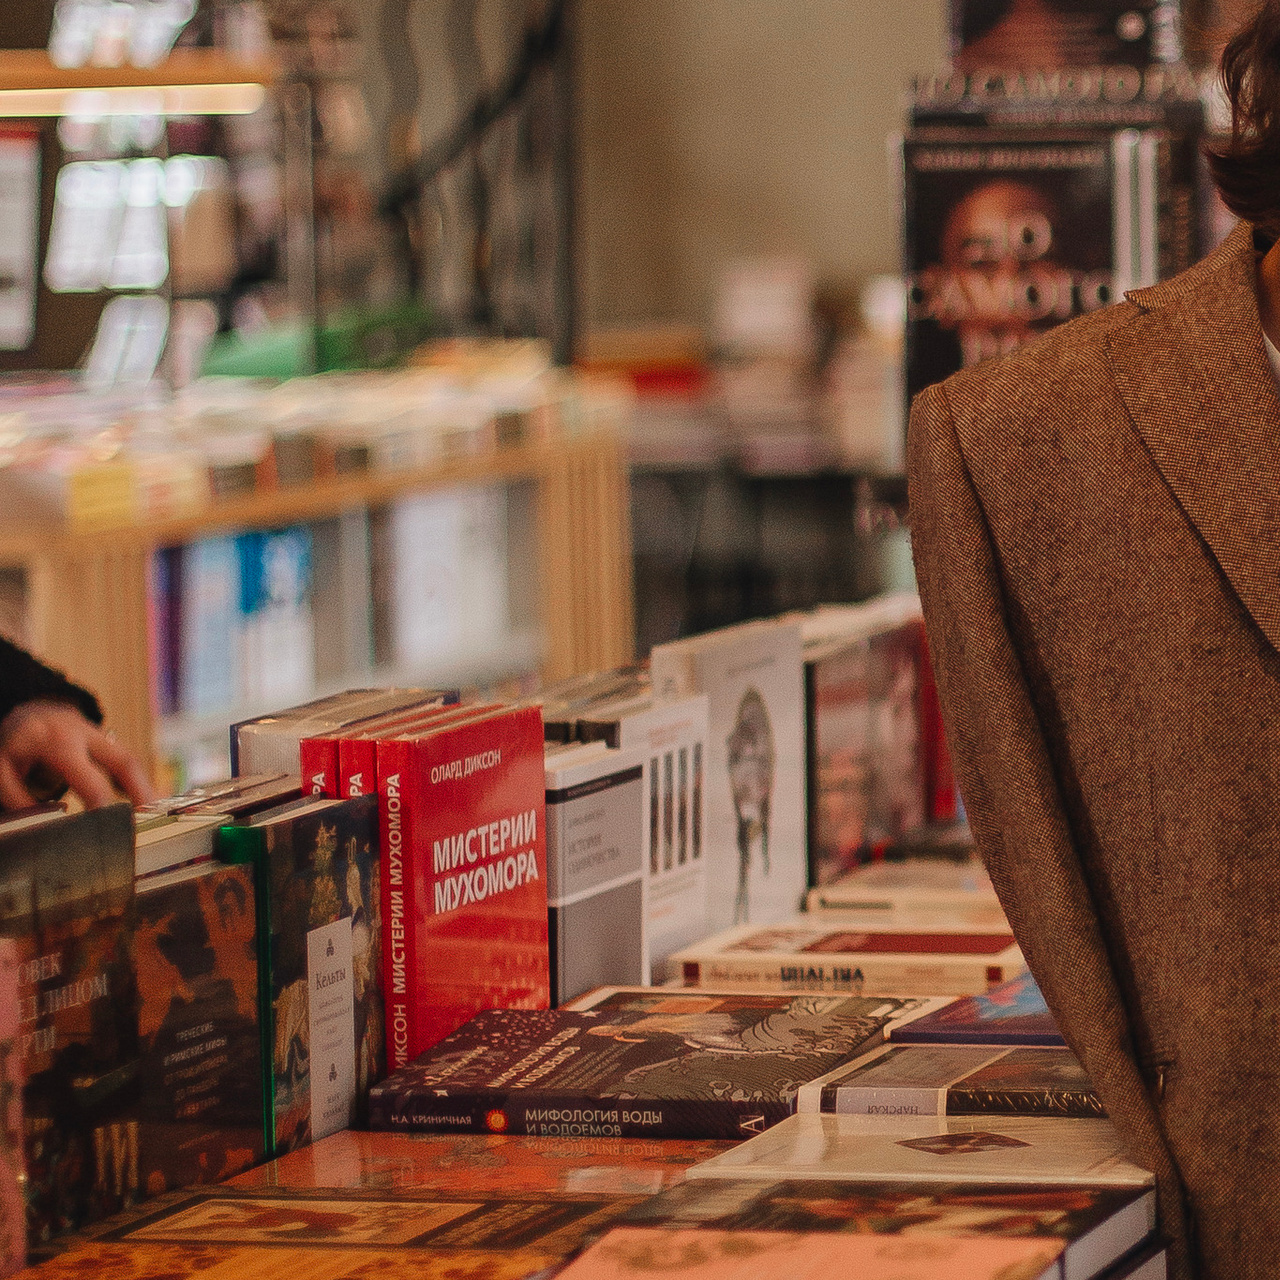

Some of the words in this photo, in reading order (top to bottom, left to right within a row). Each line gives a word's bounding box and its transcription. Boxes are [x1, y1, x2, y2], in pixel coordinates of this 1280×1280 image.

[431, 759, 463, 784] ОЛАРД
[464, 749, 501, 779] ДИКСОН
[386, 773, 404, 886] МУХОМОРА
[433, 808, 537, 875] МИСТЕРИИ
[434, 848, 539, 915] МУХОМОРА
[390, 891, 407, 994] МИСТЕРИИ
[315, 968, 346, 991] Кельты
[412, 1114, 472, 1125] КРИНИЧНАЯ
[525, 1108, 619, 1123] МИФОЛОГИЯ
[622, 1110, 663, 1126] ВОДЫ
[526, 1124, 537, 1134] И
[540, 1123, 622, 1137] ВОДОЕМОВ
